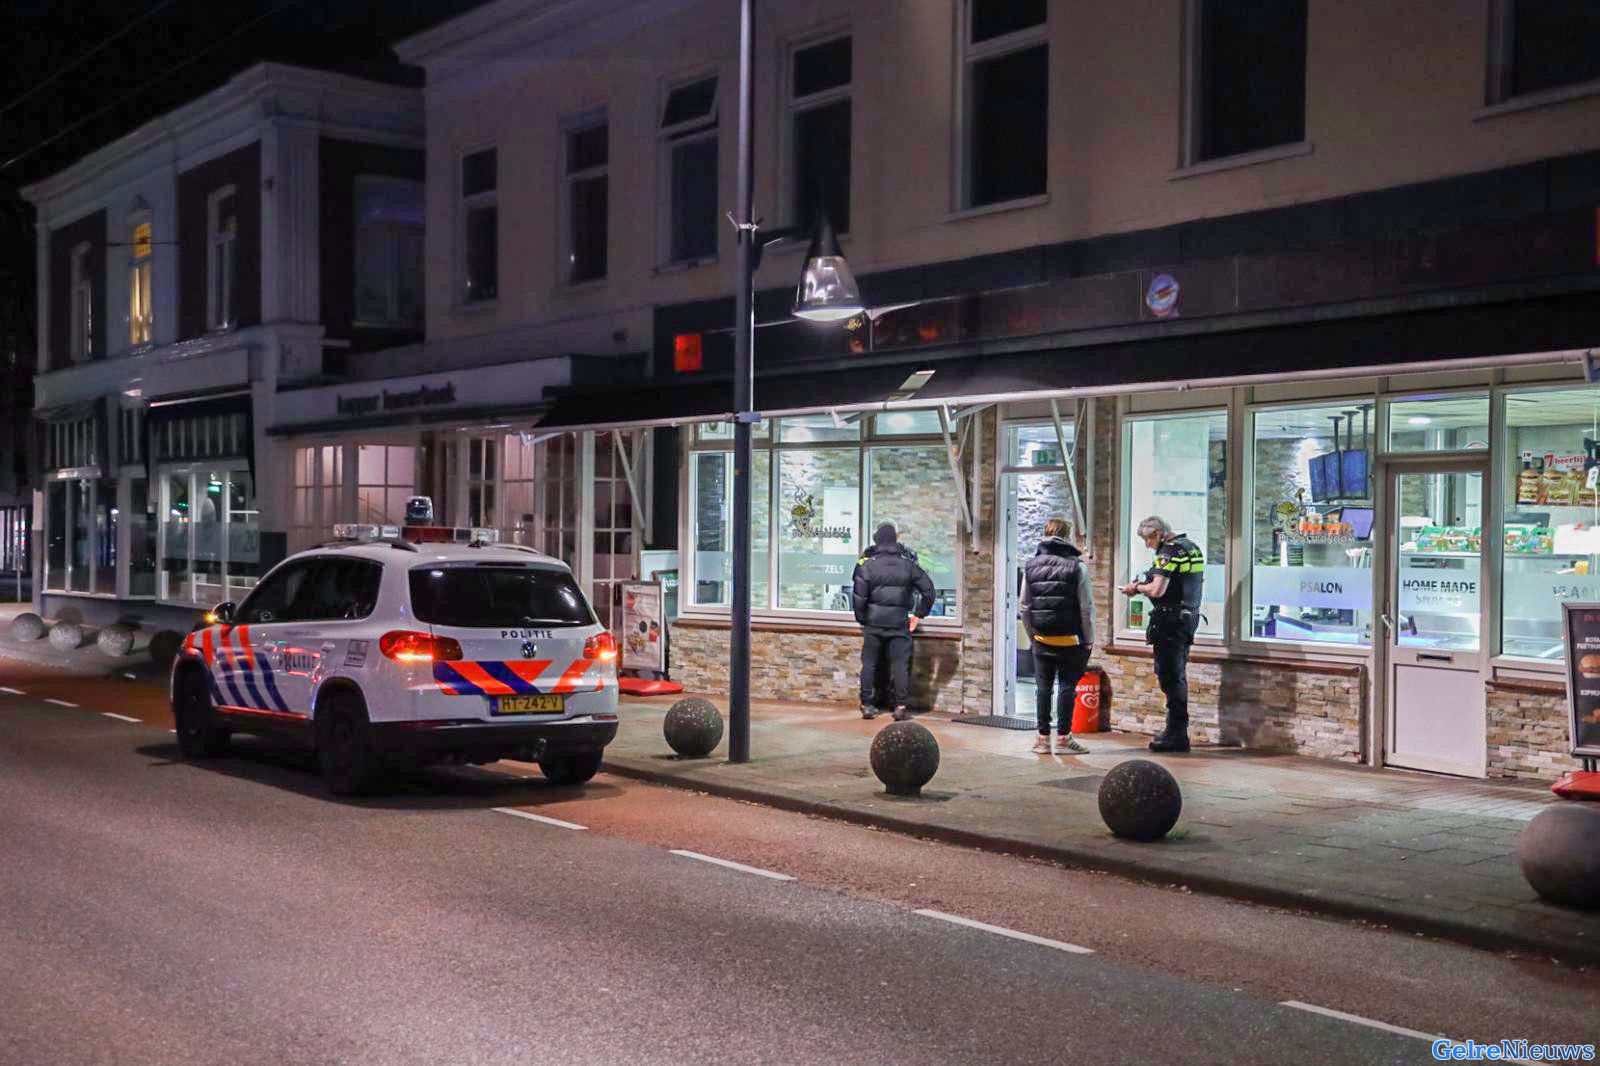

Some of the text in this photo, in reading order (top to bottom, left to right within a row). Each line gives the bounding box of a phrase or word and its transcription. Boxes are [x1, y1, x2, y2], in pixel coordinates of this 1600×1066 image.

[1403, 579, 1477, 594] HOME MADE
[501, 630, 553, 639] POLITIE
[501, 697, 559, 710] HT-242-V
